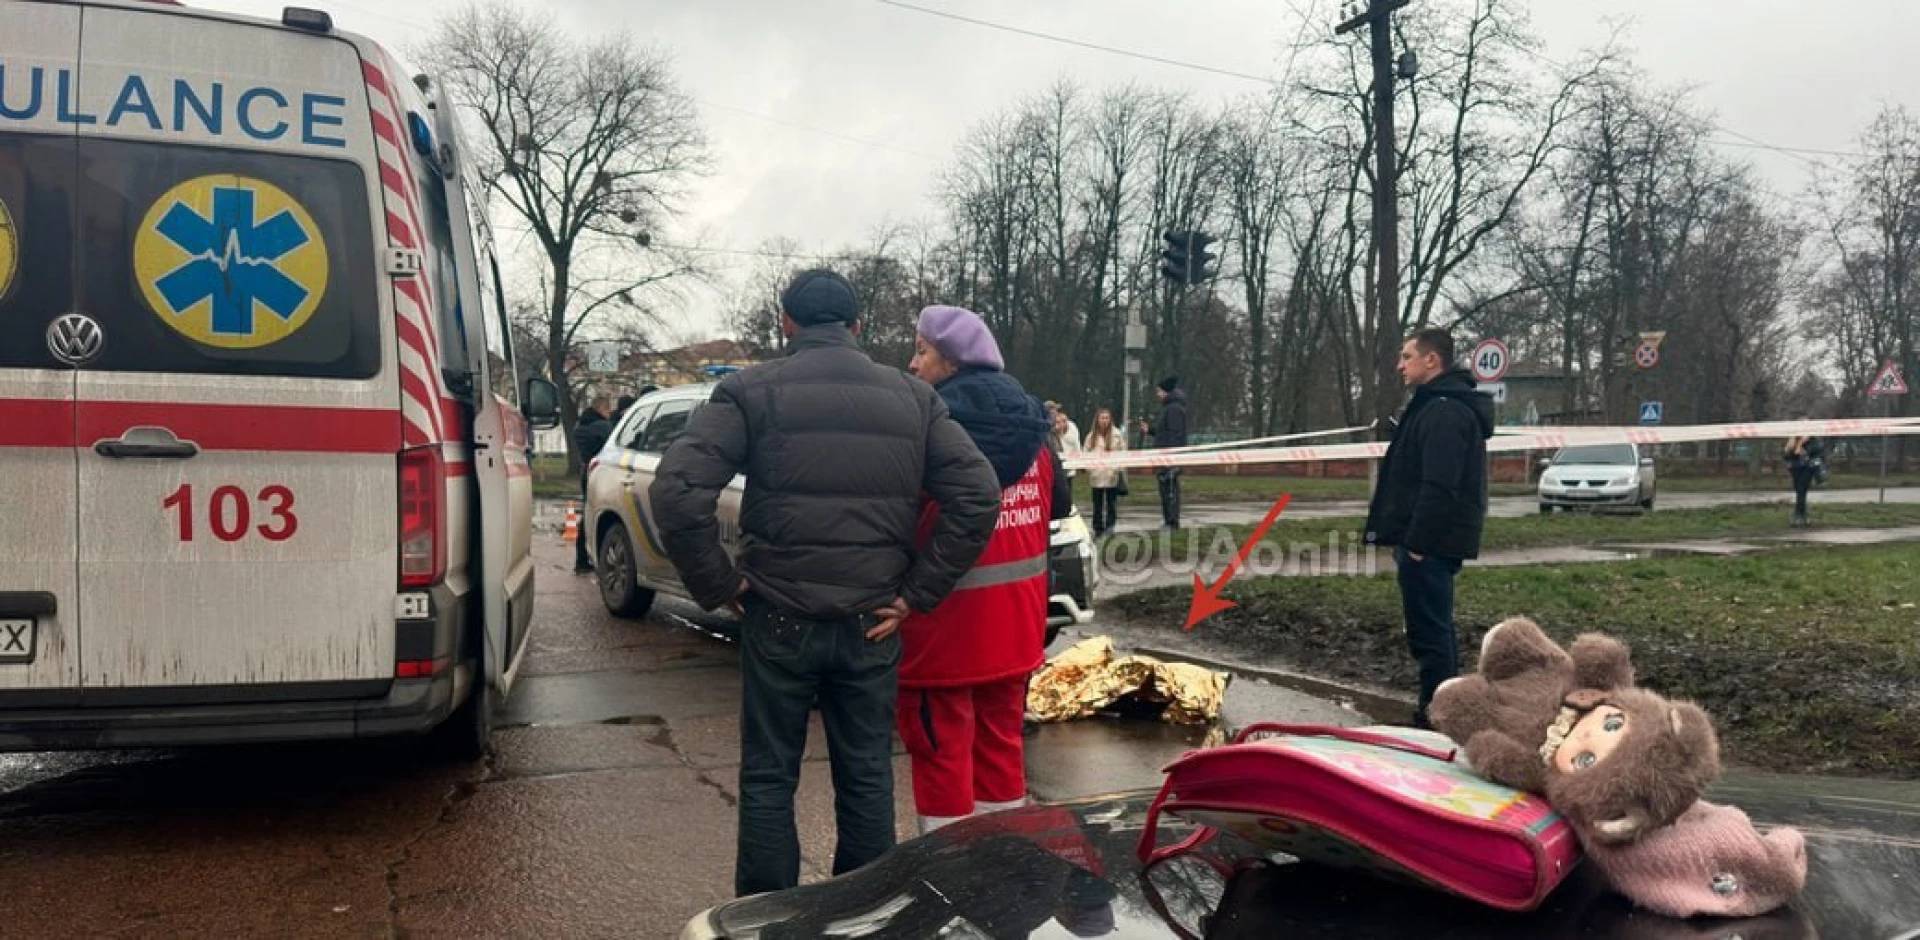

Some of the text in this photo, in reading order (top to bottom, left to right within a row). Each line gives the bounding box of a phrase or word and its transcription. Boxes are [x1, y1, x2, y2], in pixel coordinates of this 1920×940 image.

[0, 64, 346, 147] ULANCE
[1479, 352, 1500, 370] 40
[163, 483, 299, 542] 103
[0, 623, 27, 652] X
